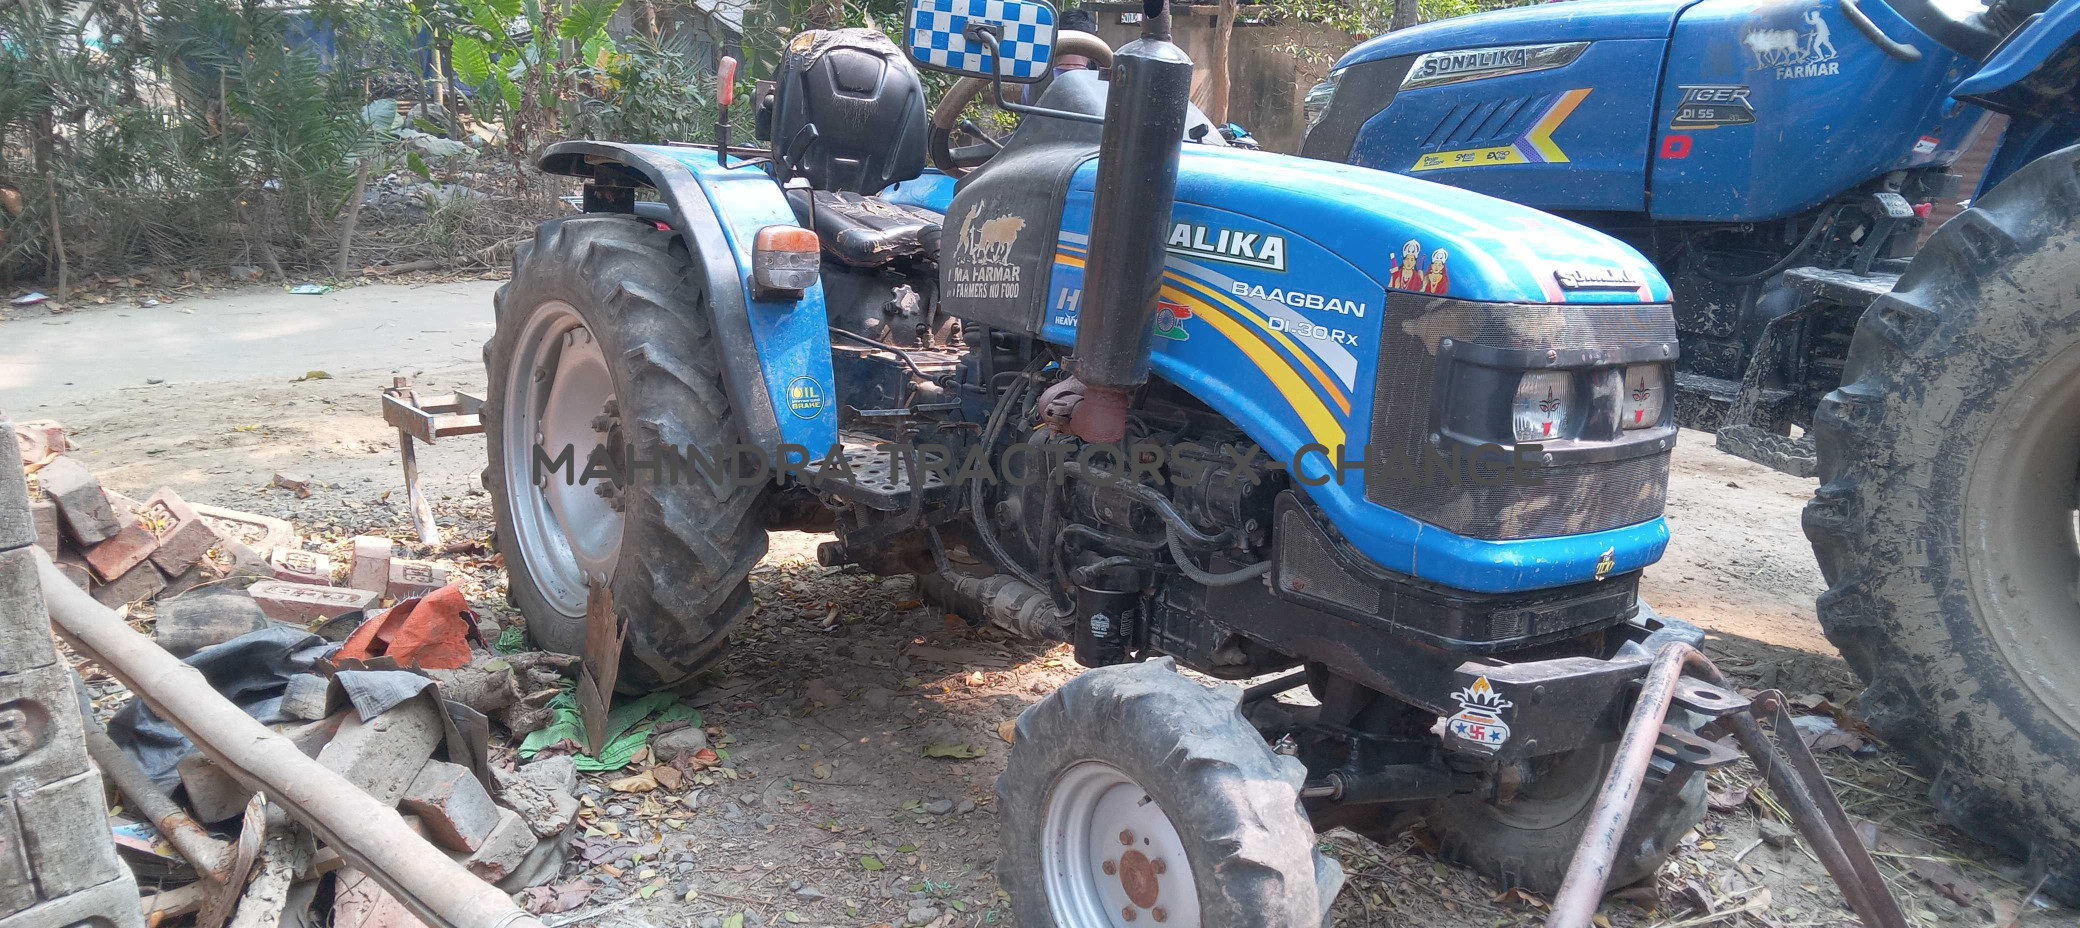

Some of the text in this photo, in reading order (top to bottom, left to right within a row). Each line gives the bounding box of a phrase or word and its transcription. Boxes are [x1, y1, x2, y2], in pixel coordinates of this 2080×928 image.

[1423, 49, 1527, 77] SONALIKA
[1776, 62, 1840, 80] FARMAR
[1678, 84, 1755, 111] TIGER
[1683, 108, 1715, 119] DI 55
[1167, 223, 1286, 271] ALIKA
[956, 283, 988, 298] FARMERS
[989, 283, 1000, 298] NO
[1001, 283, 1020, 298] FOOD
[1231, 280, 1366, 318] BAAGBAN
[1055, 314, 1078, 327] HEAVY
[791, 386, 819, 398] OIL
